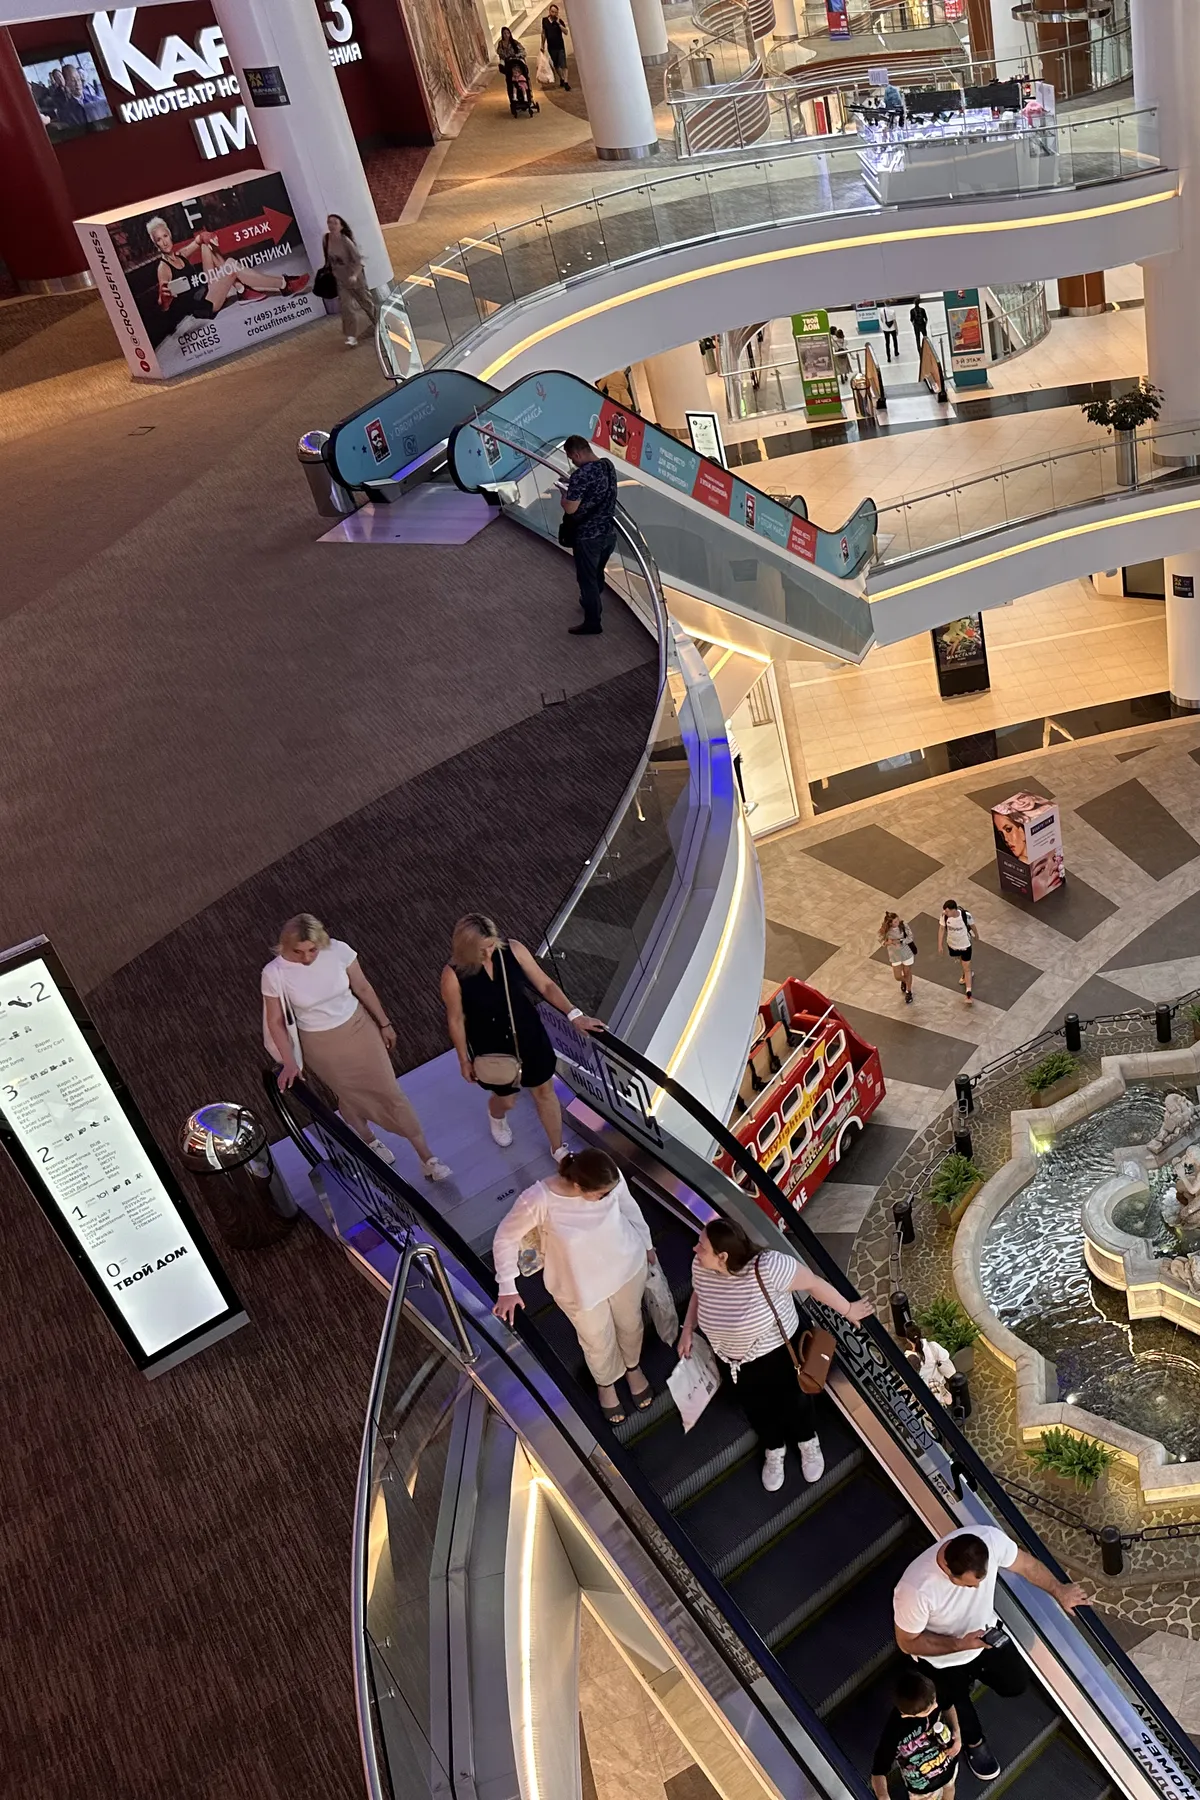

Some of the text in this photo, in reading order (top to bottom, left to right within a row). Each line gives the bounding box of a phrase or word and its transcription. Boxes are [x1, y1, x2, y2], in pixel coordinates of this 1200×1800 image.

[120, 81, 217, 124] КИНОТЕАТР
[194, 105, 257, 160] IM
[234, 222, 271, 242] 3 ЭТАЖ
[190, 242, 292, 288] #ОДНОКЛУБНИКИ
[89, 230, 140, 346] @CROCUSFITNESS
[244, 296, 309, 326] +7 (495) 236-16-00
[247, 306, 313, 337] crocusfitness.com
[802, 317, 818, 325] ТВОЙ
[178, 323, 217, 346] CROCUS
[803, 324, 820, 332] ДОМ
[181, 334, 221, 357] FITNESS
[30, 982, 51, 1002] 2
[2, 1085, 18, 1101] 3
[37, 1146, 54, 1163] 2
[72, 1206, 87, 1220] 1
[106, 1263, 121, 1278] 0
[113, 1246, 188, 1291] ТВОЙ ДОМ
